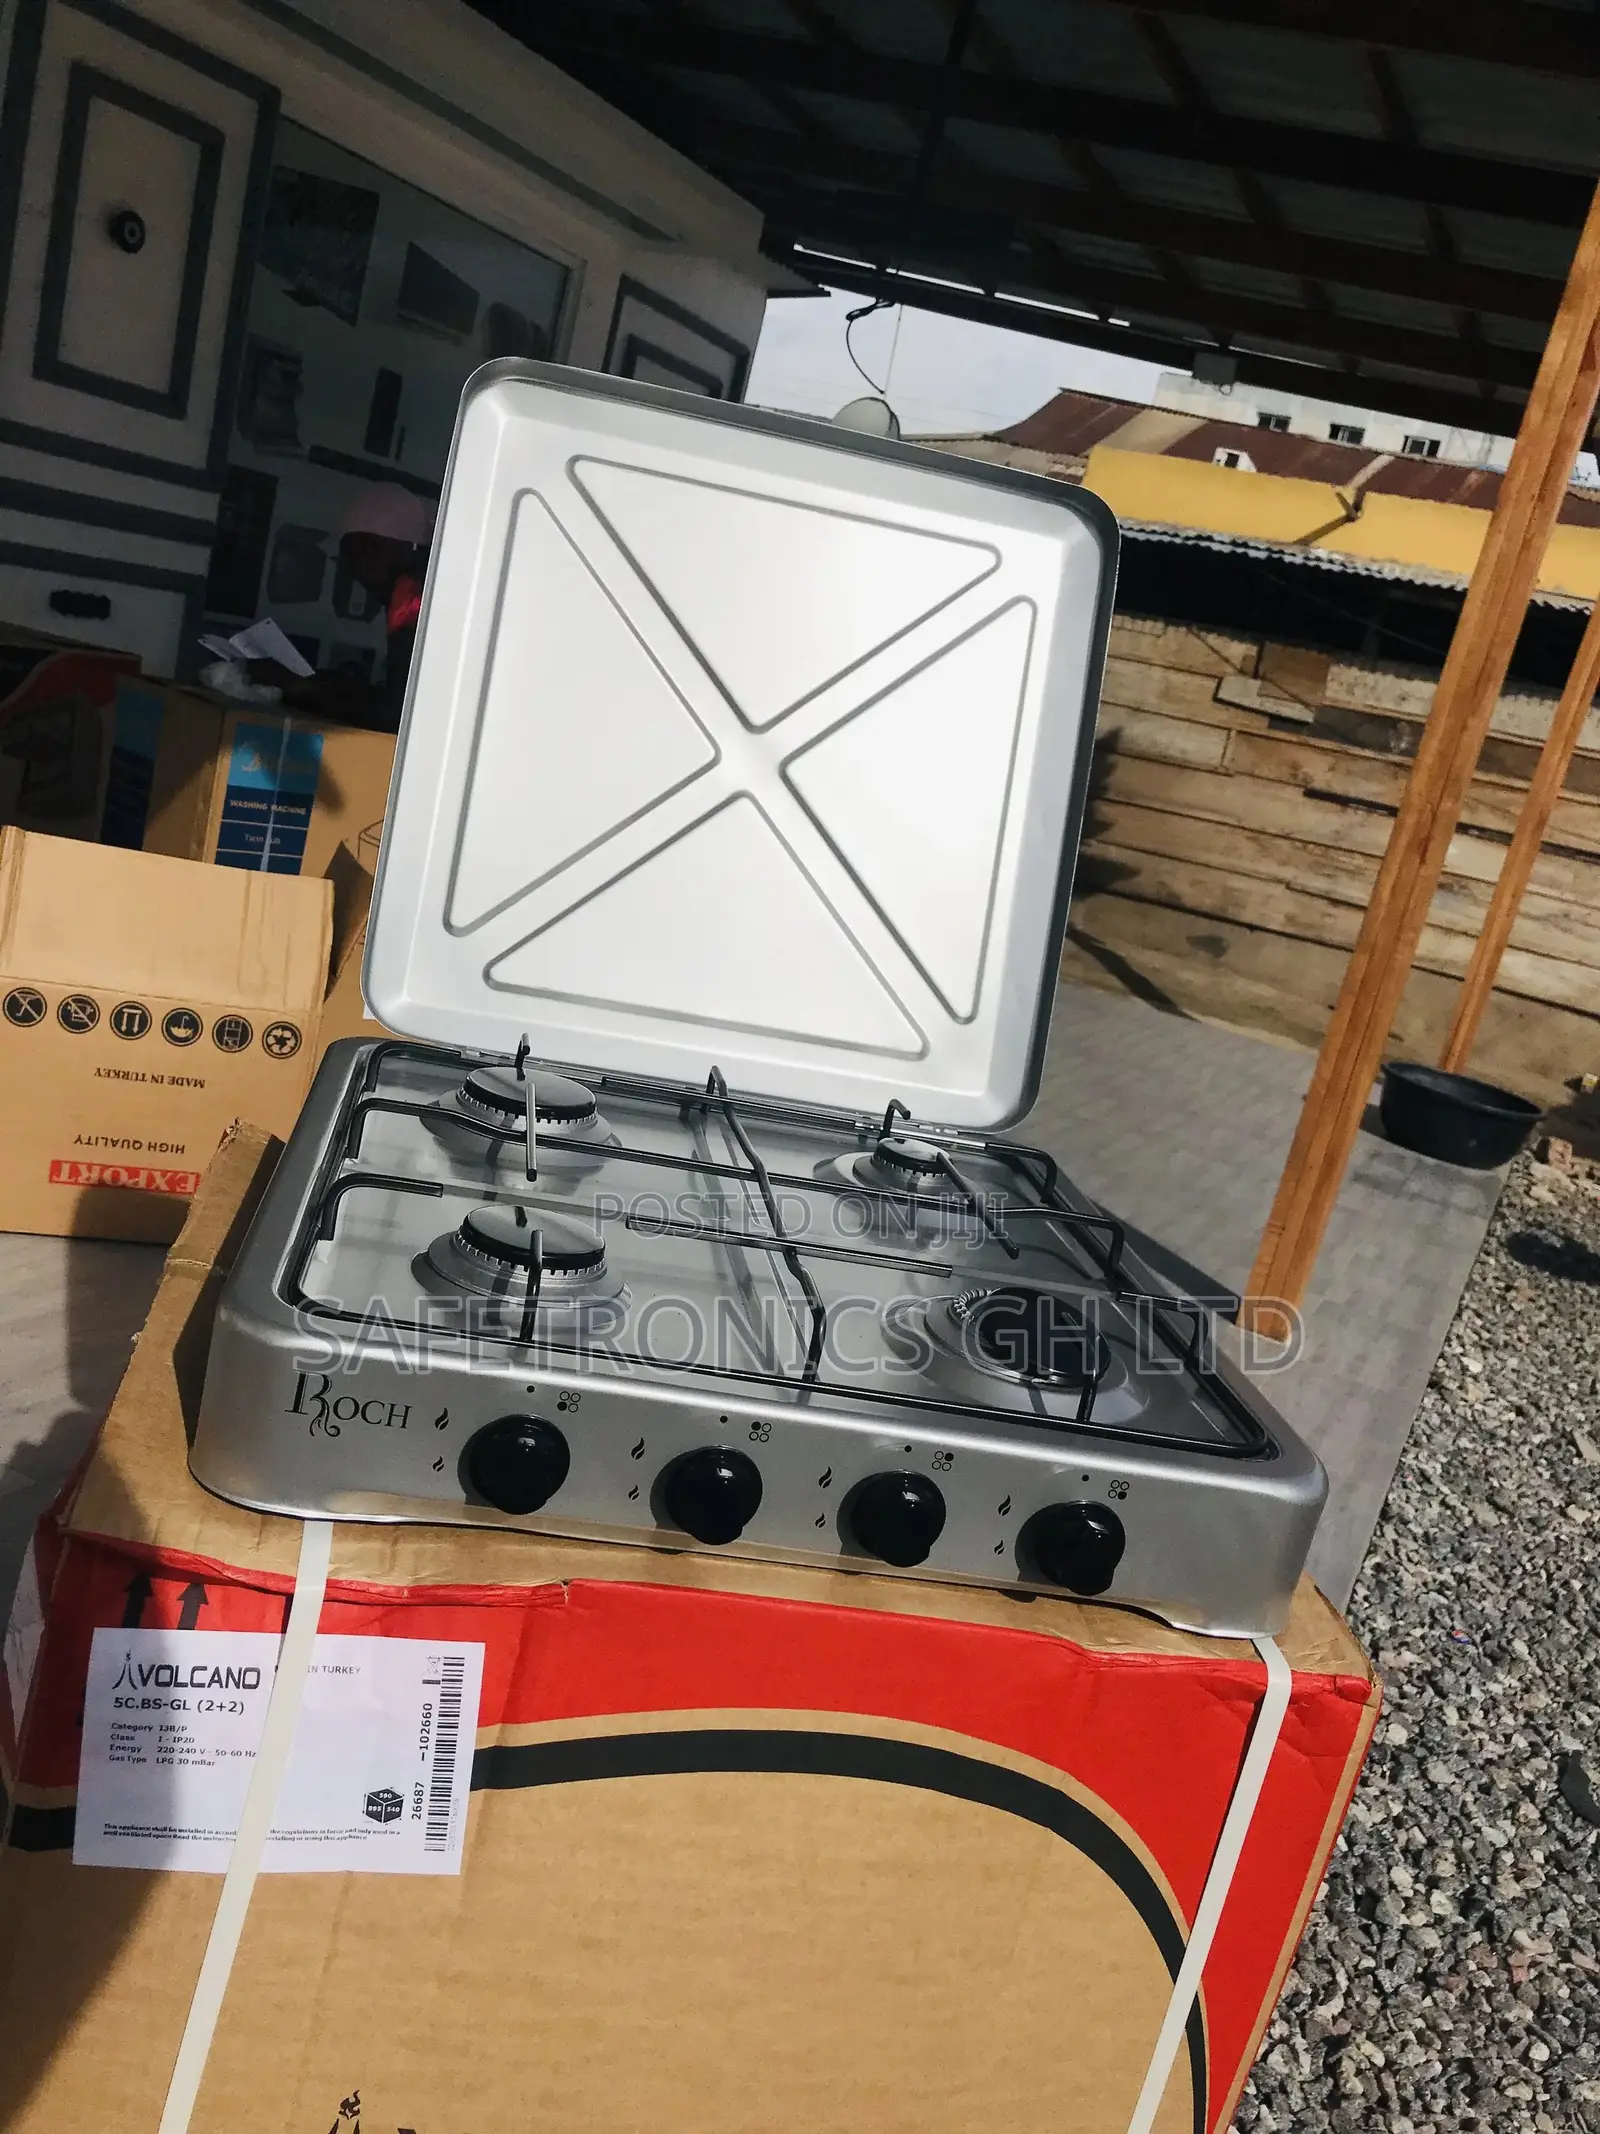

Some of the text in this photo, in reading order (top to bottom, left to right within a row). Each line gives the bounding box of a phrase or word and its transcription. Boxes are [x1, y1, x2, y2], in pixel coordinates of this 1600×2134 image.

[230, 800, 306, 815] WASHING MACHINE
[244, 833, 264, 843] Twin
[94, 1067, 205, 1088] MADE IN TURKEY
[74, 1134, 185, 1154] HIGH QUALITY
[52, 1161, 196, 1193] EXPORT
[137, 1663, 261, 1690] VOLCANO
[322, 1665, 361, 1674] TURKEY
[113, 1696, 245, 1716] 5C.BS-GL (2+2)
[111, 1722, 154, 1732] Category
[110, 1733, 135, 1741] Class
[172, 1736, 195, 1744] IP20
[109, 1743, 142, 1753] Energy
[157, 1746, 196, 1754] 220-240
[215, 1749, 242, 1757] 50-60
[245, 1750, 257, 1758] Hz
[109, 1754, 126, 1762] Gas
[127, 1755, 147, 1764] Type
[156, 1757, 174, 1765] LPG
[177, 1757, 189, 1765] 30
[411, 1781, 425, 1820] 26687
